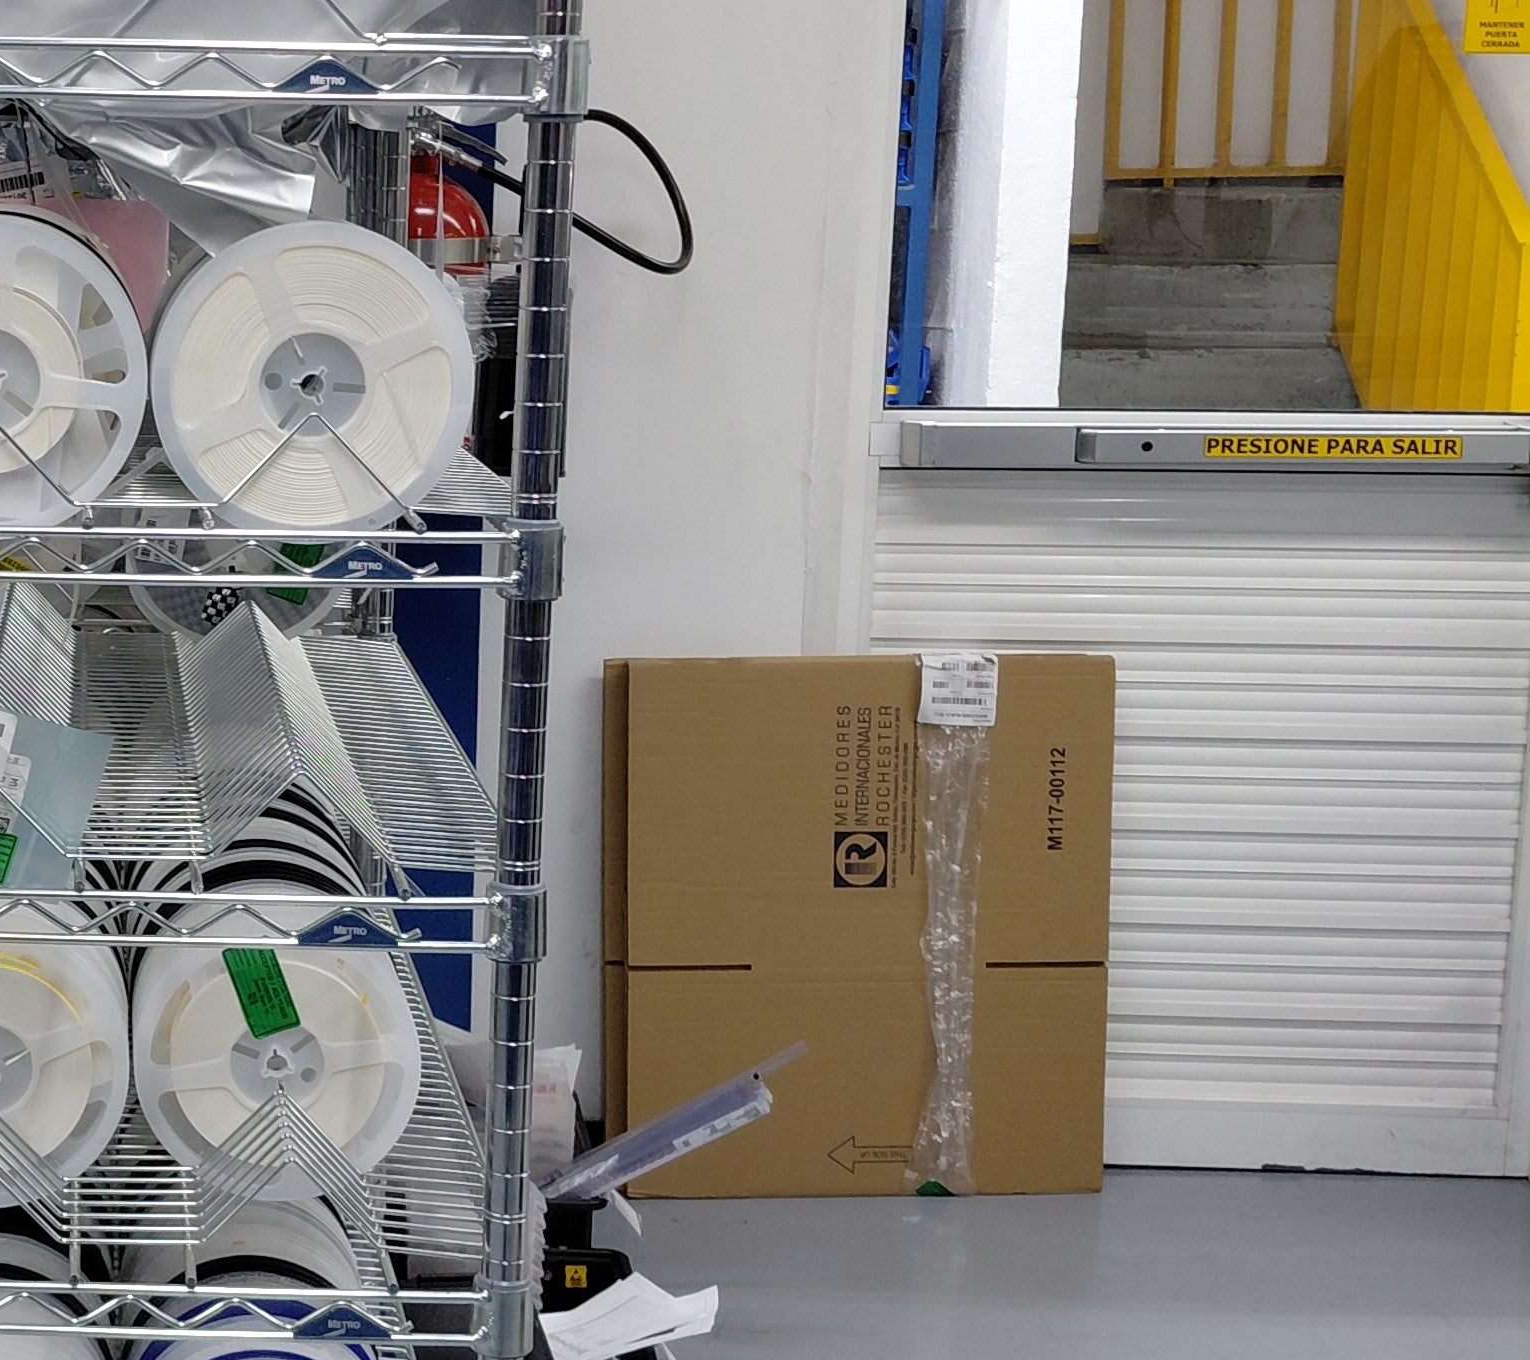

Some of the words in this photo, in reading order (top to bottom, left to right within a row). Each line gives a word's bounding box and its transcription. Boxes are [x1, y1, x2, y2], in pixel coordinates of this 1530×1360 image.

[1479, 21, 1525, 29] MANTENER
[1485, 30, 1518, 38] PUERTA
[1481, 40, 1520, 48] CERRADA
[309, 74, 346, 88] METRO
[1206, 438, 1319, 455] PRESIONE
[1326, 438, 1385, 455] PARA
[1392, 438, 1458, 456] SALIR
[347, 560, 383, 573] METRO
[834, 705, 851, 826] MEDIDORES
[854, 706, 872, 827] INTERNACIONALES
[876, 705, 893, 827] ROCHESTER
[1047, 747, 1067, 851] M117-00112
[333, 925, 368, 938] METRO
